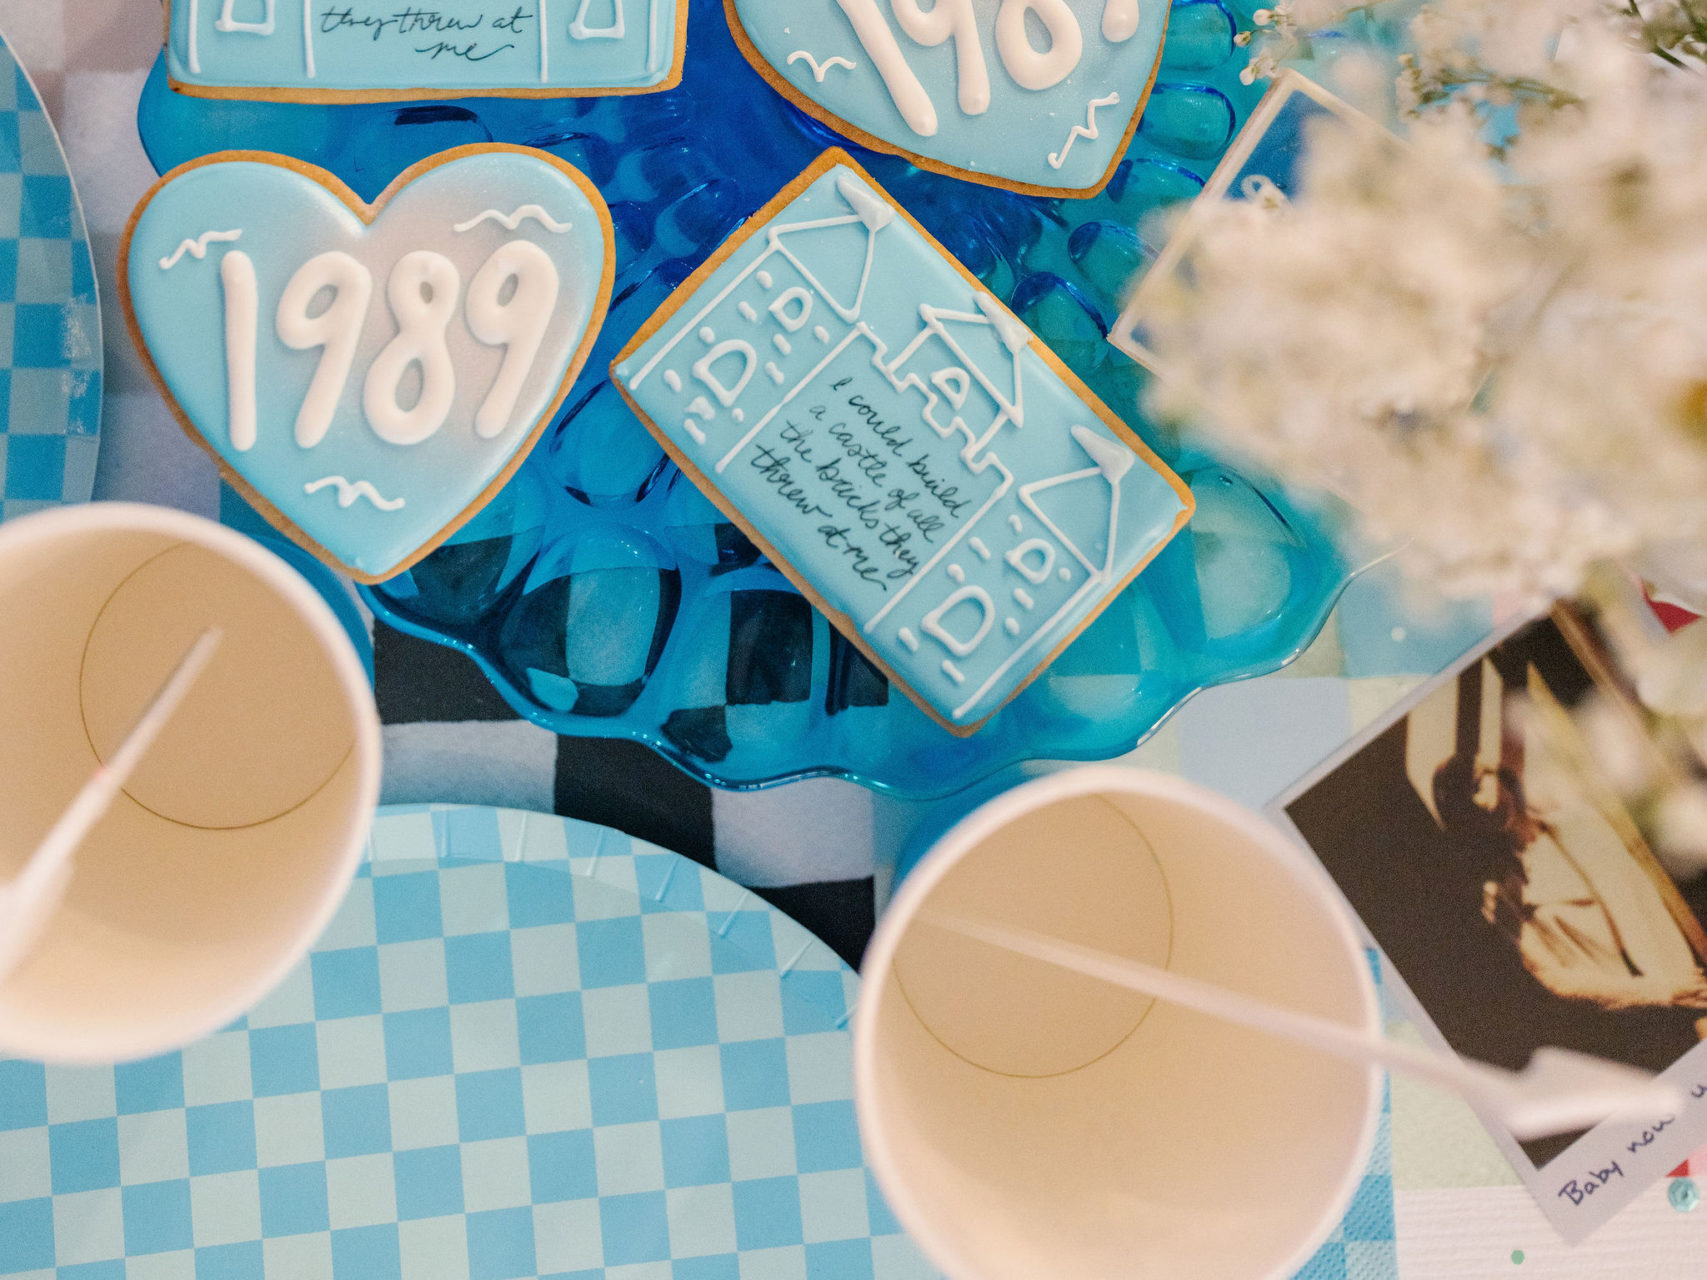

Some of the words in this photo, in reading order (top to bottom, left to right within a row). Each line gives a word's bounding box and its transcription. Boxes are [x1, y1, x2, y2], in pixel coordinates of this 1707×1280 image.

[320, 6, 397, 41] they
[393, 6, 482, 33] threw
[492, 6, 533, 33] at
[415, 41, 515, 61] me
[221, 240, 560, 452] 1989
[751, 444, 833, 518] threw
[817, 524, 850, 548] at
[843, 546, 887, 591] me
[779, 420, 814, 463] the
[816, 458, 880, 529] bricks
[879, 523, 919, 580] they
[809, 405, 826, 421] a
[828, 422, 888, 488] castle
[884, 488, 920, 510] of
[907, 509, 945, 544] all
[848, 395, 913, 457] could
[906, 454, 972, 519] build
[1558, 1160, 1624, 1206] Baby
